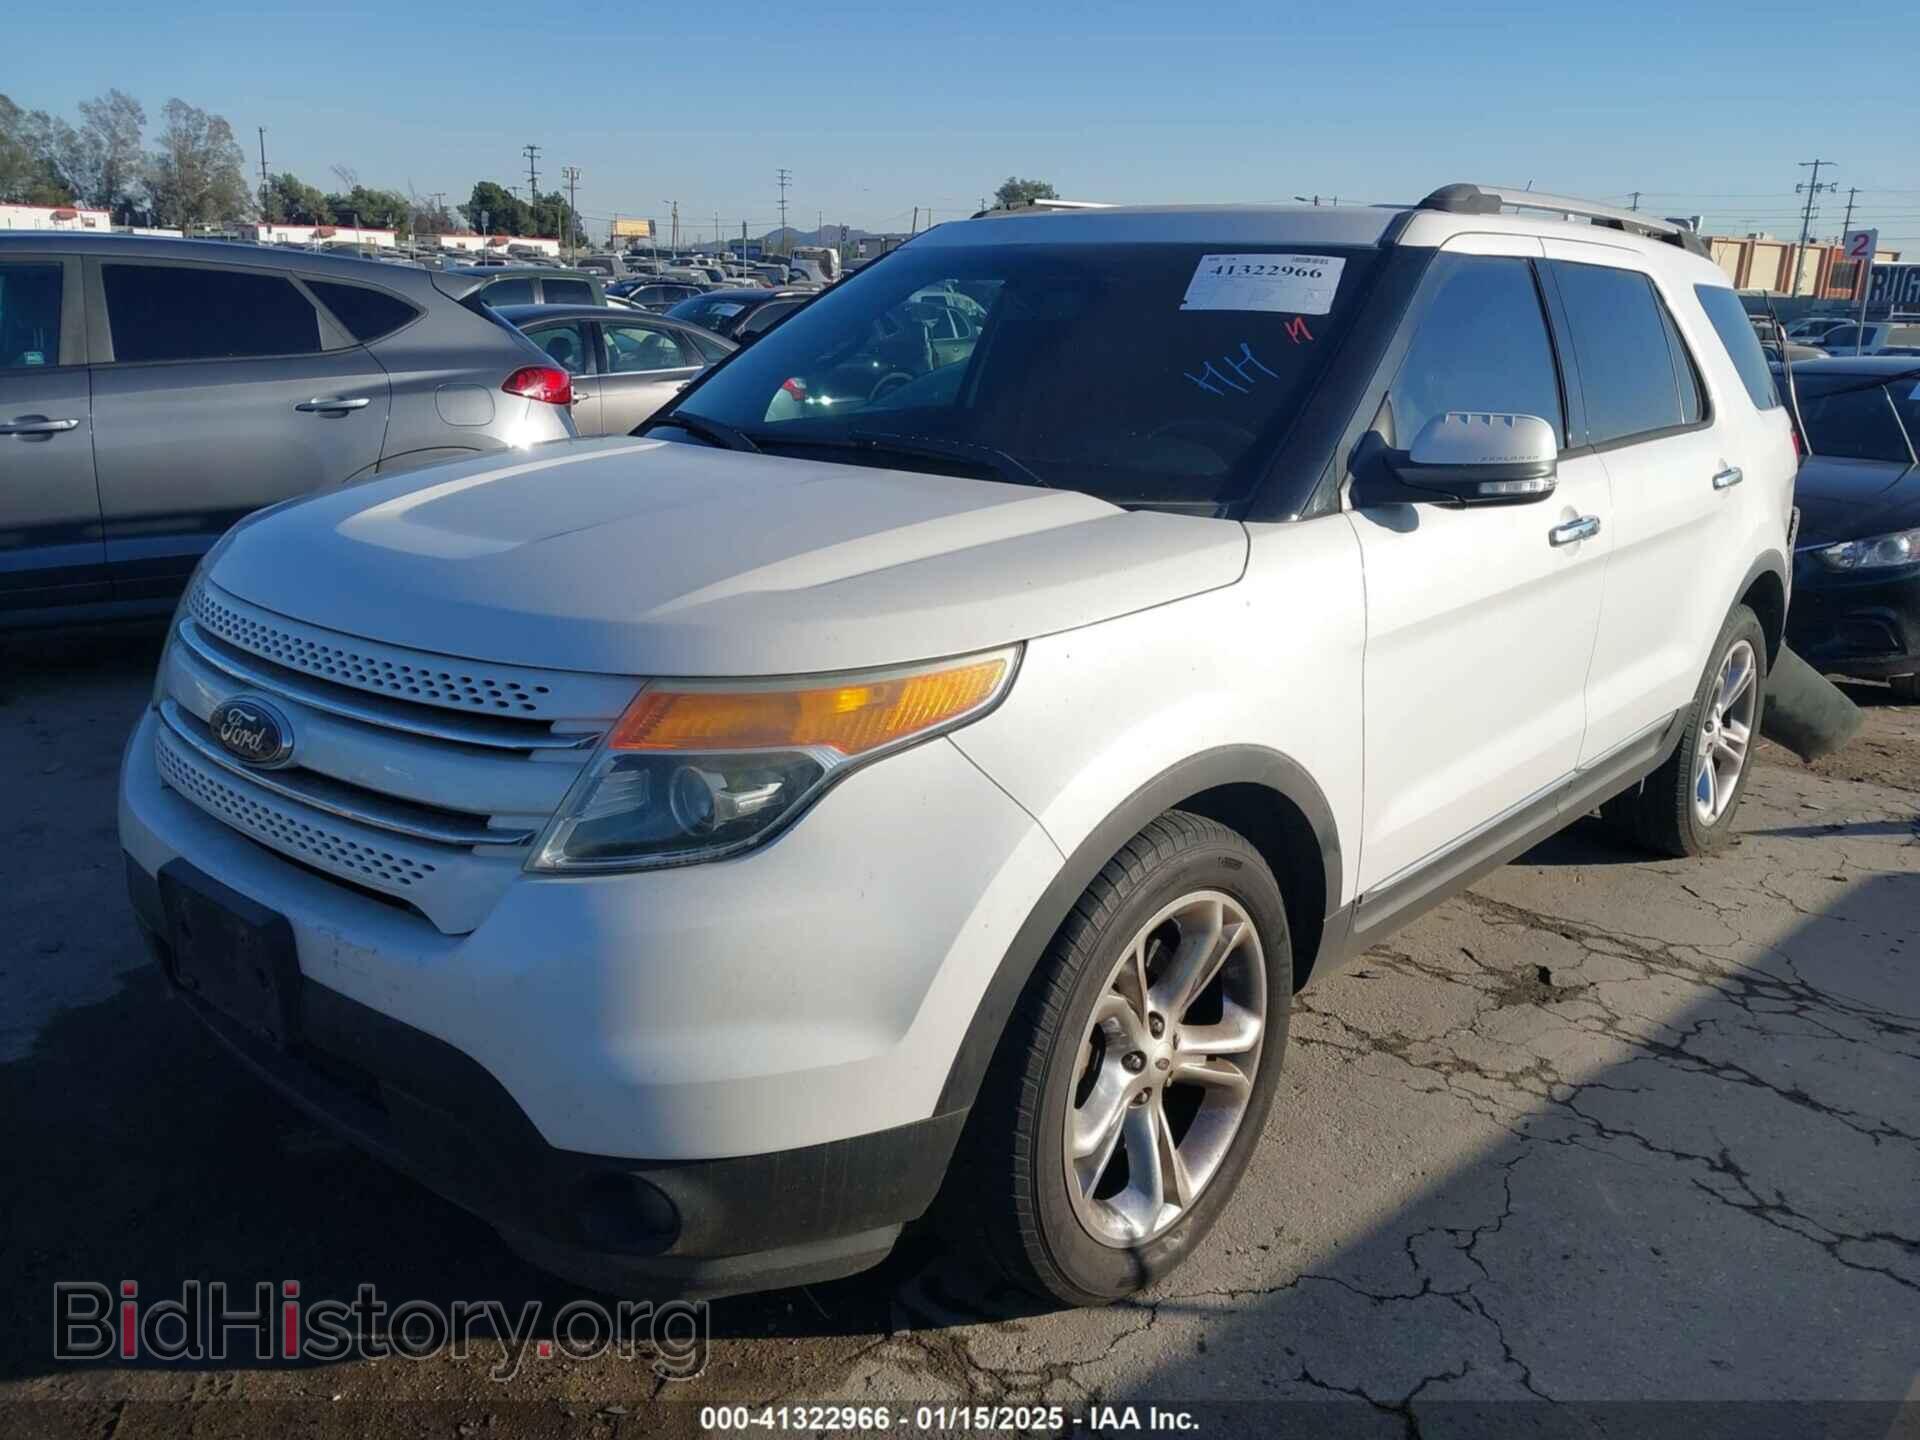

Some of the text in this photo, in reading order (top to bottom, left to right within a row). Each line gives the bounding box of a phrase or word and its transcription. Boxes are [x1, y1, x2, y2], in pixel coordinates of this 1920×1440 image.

[1852, 234, 1869, 255] 2
[1209, 264, 1323, 280] 41322966
[221, 708, 267, 752] Ford
